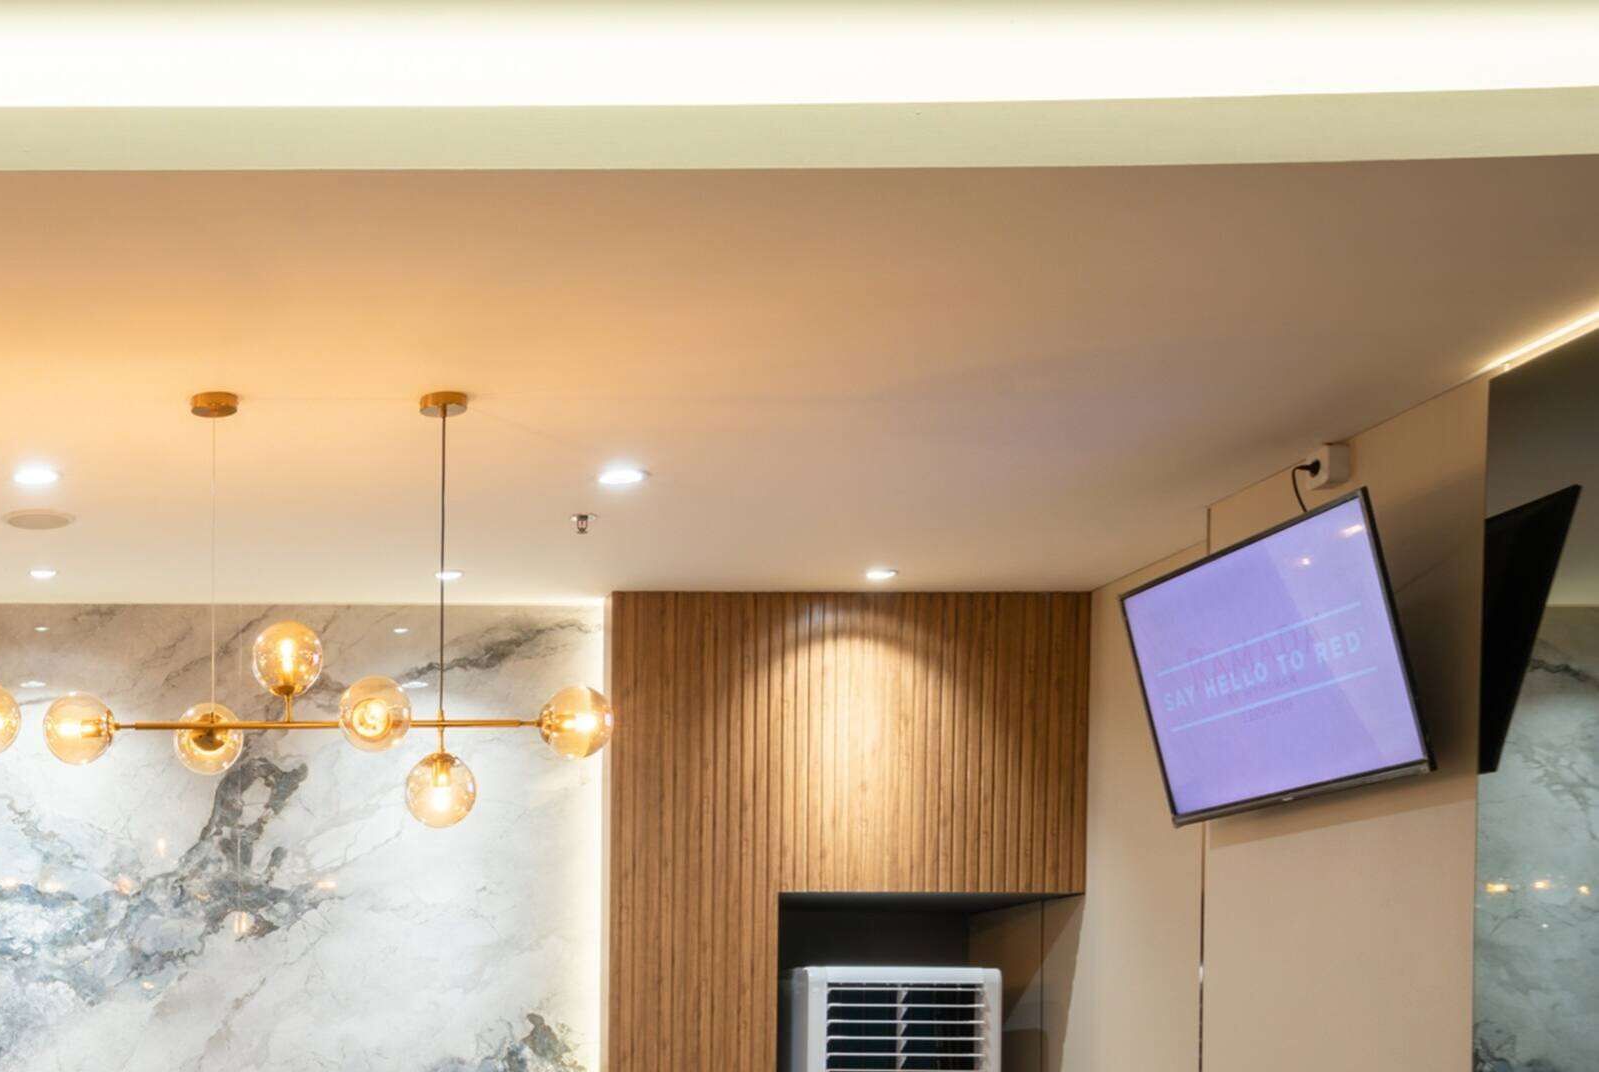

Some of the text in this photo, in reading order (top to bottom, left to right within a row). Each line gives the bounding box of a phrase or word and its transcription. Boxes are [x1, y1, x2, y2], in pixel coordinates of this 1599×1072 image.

[1164, 686, 1196, 712] SAY
[1203, 661, 1268, 700] HELLO
[1277, 650, 1305, 676] TO
